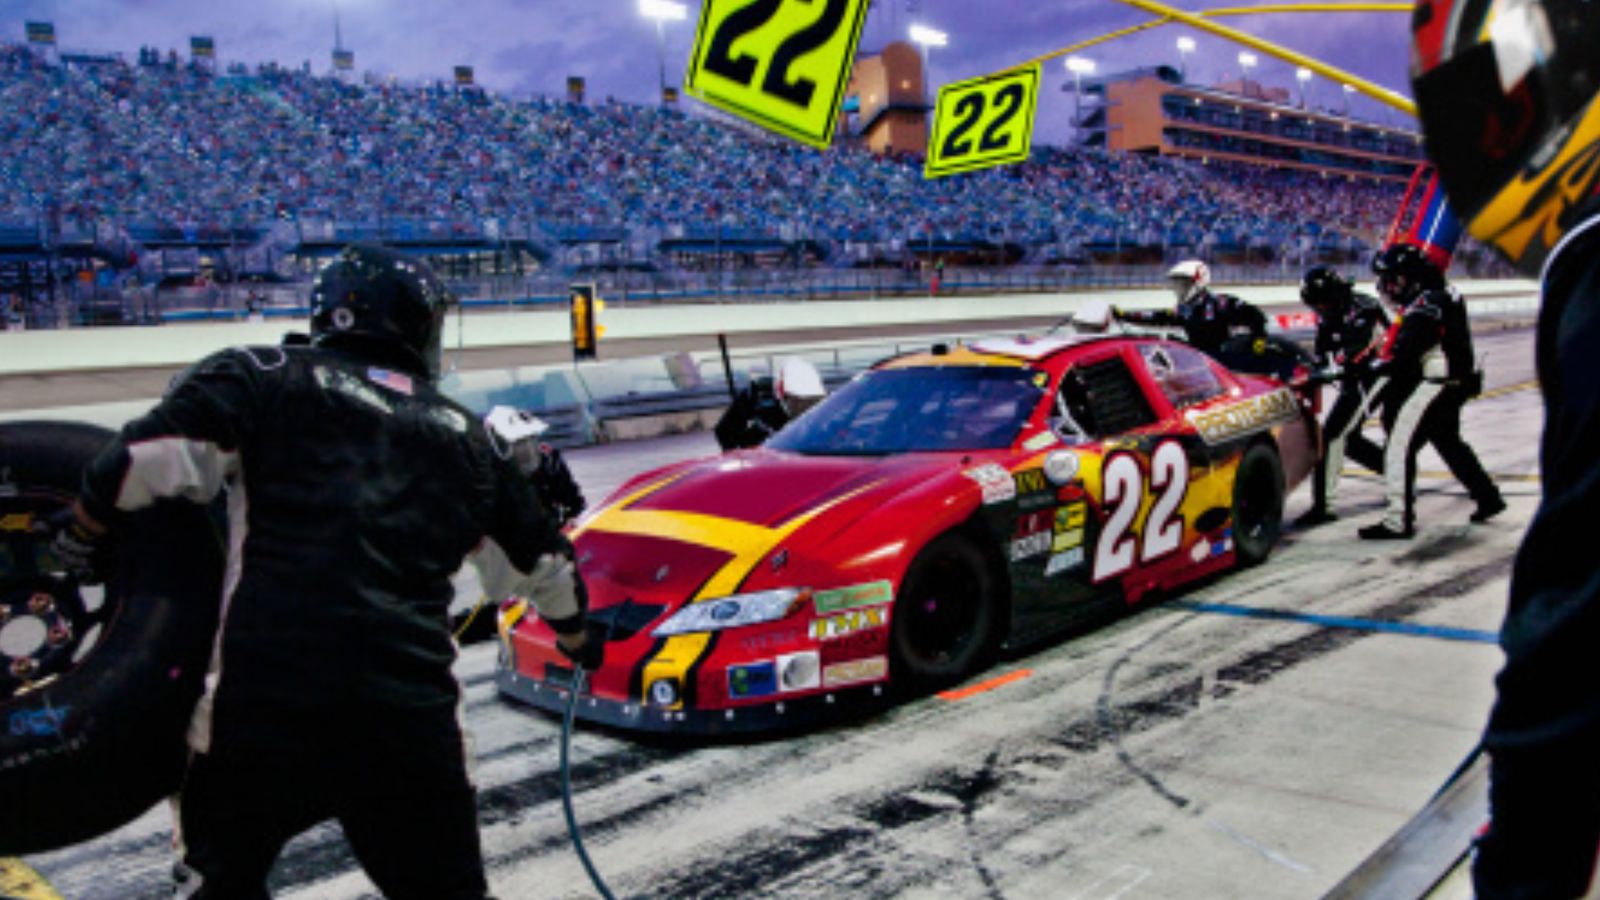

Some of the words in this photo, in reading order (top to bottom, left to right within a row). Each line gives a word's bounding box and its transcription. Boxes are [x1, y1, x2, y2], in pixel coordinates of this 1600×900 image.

[703, 0, 848, 109] 22
[941, 85, 1024, 158] 22
[1092, 438, 1189, 584] 22
